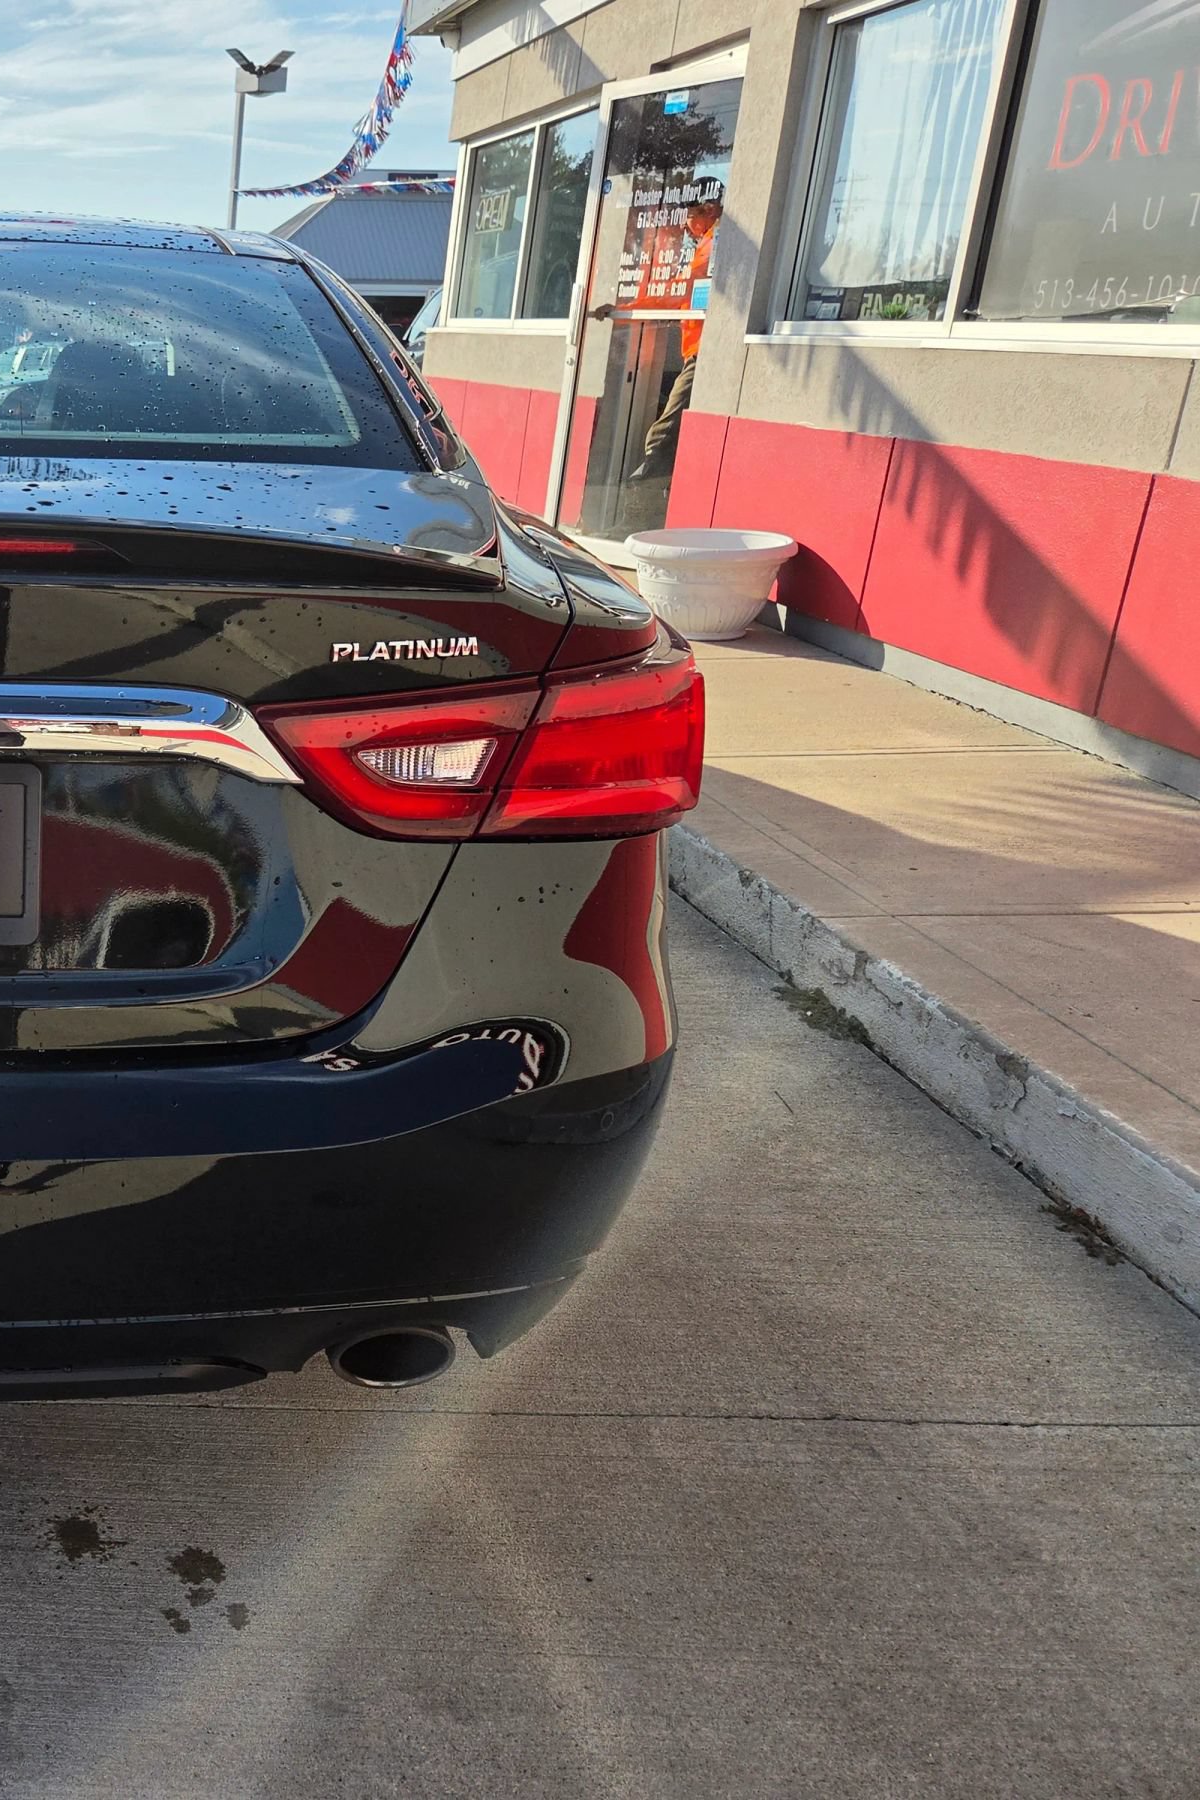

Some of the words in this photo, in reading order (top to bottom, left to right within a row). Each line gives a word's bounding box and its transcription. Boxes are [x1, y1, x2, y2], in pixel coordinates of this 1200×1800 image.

[1046, 68, 1200, 170] DRI
[634, 190, 662, 207] Chester
[663, 186, 680, 204] Auto
[706, 180, 721, 200] LLC
[618, 267, 644, 283] Saturday
[652, 265, 671, 281] 10:00
[332, 636, 479, 662] PLATINUM
